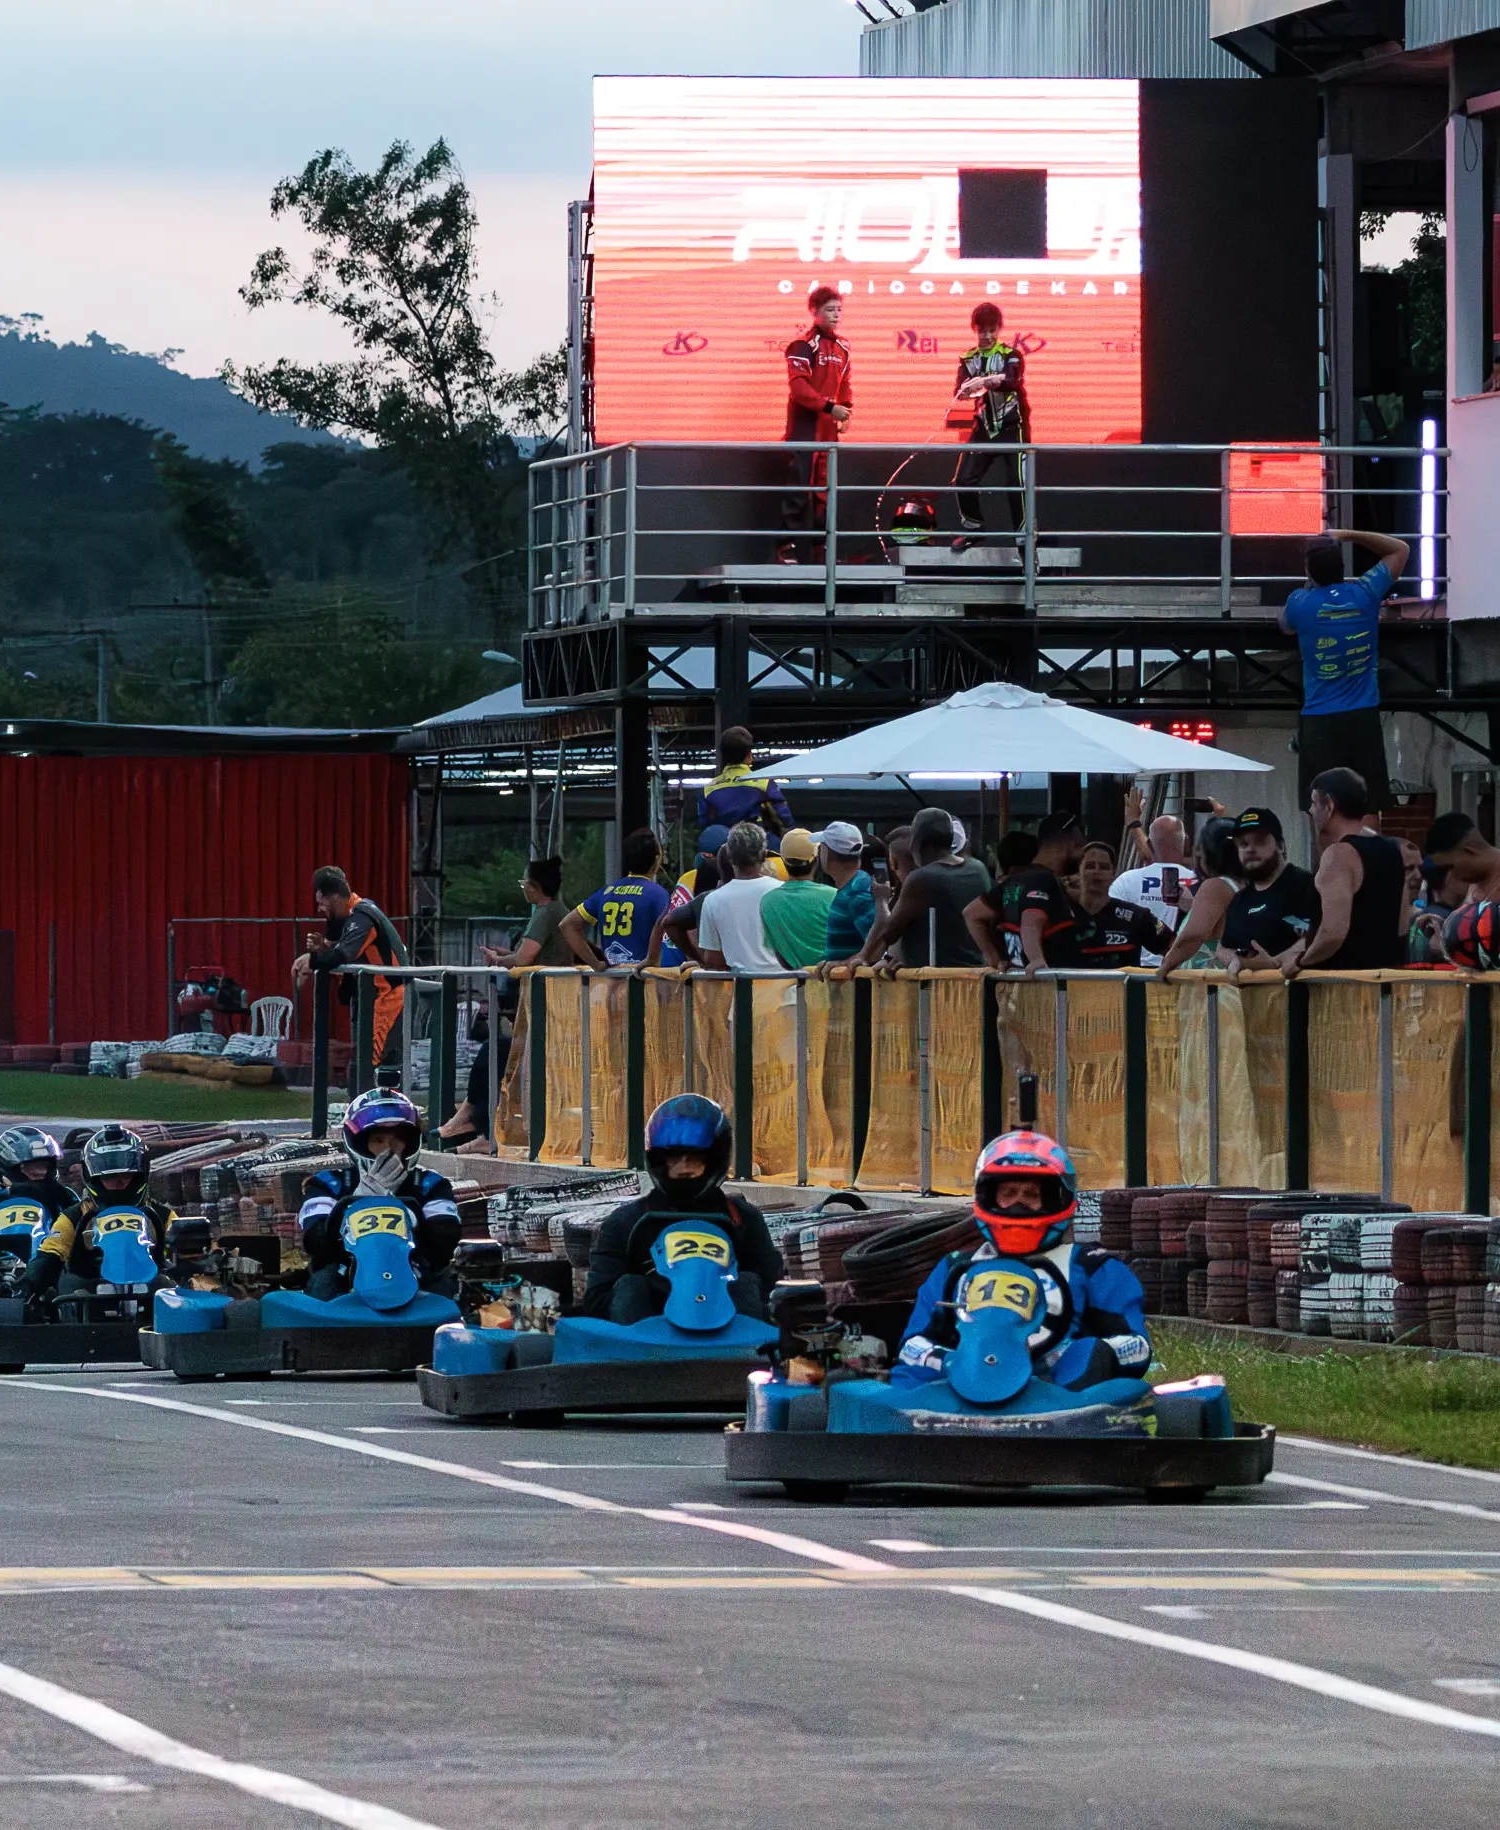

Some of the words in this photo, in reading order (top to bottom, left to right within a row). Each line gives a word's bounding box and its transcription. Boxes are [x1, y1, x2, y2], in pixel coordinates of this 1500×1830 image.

[986, 279, 1030, 295] DE
[602, 901, 635, 937] 33
[5, 1210, 41, 1224] 19
[103, 1218, 144, 1232] 03
[357, 1213, 404, 1233] 37
[672, 1238, 726, 1259] 23
[977, 1277, 1031, 1308] 13
